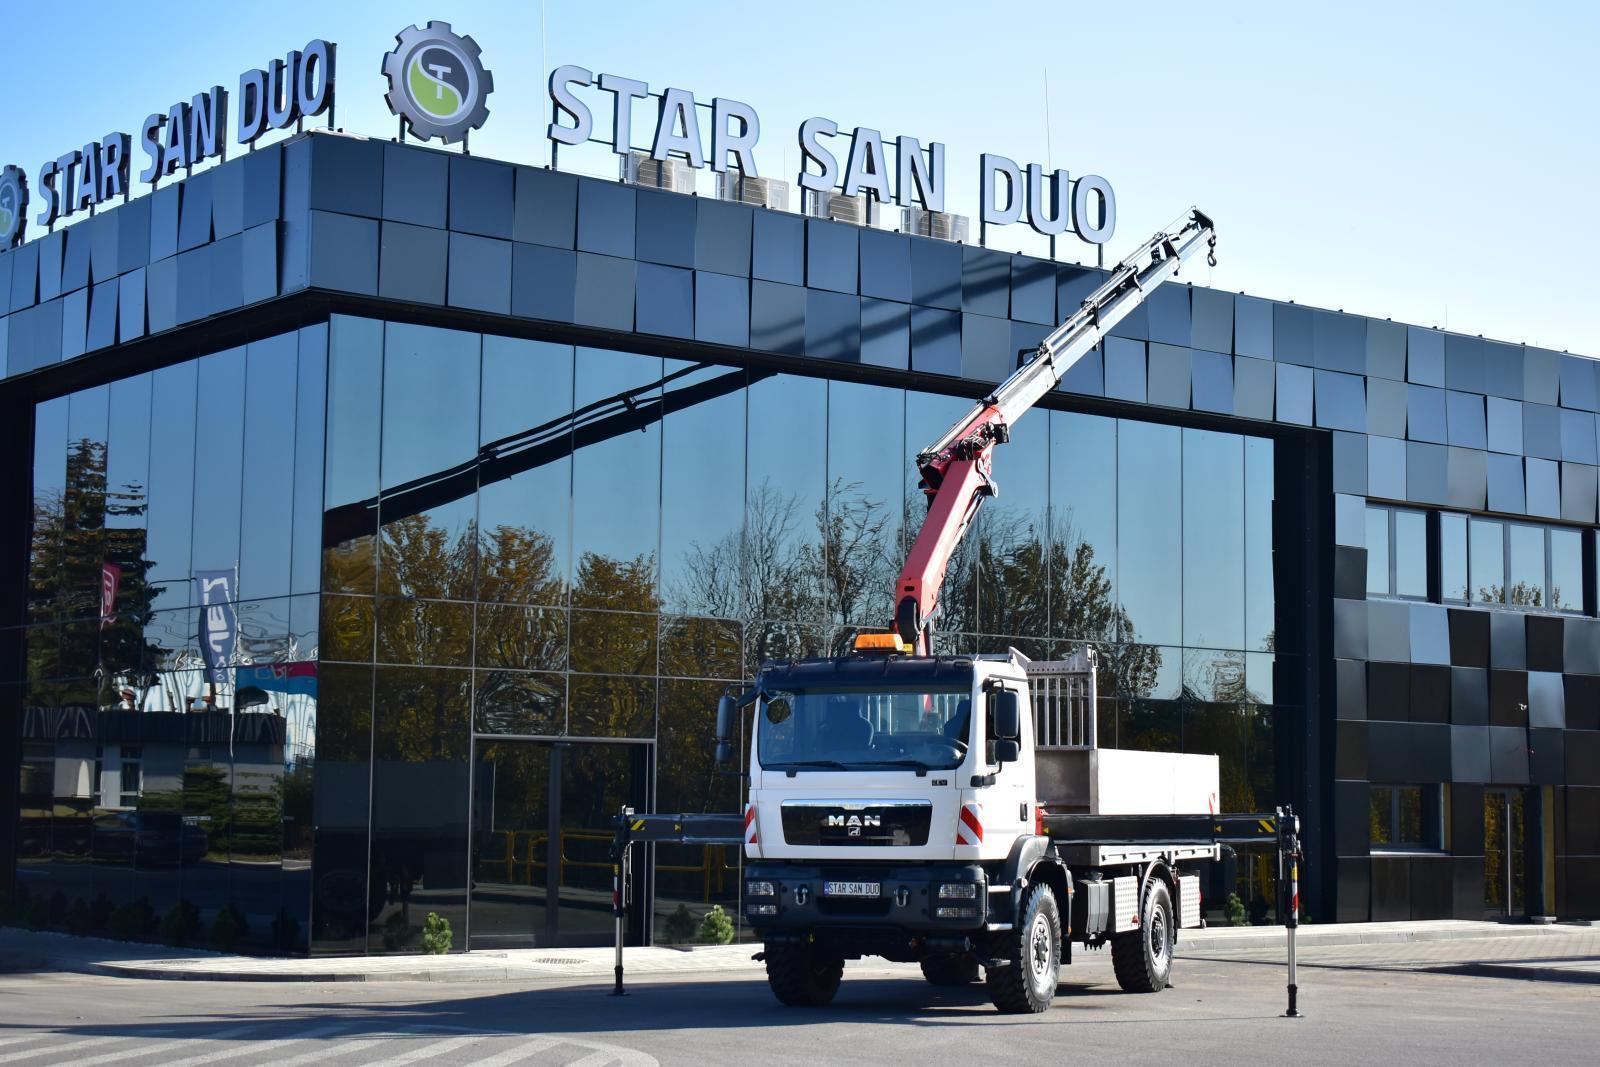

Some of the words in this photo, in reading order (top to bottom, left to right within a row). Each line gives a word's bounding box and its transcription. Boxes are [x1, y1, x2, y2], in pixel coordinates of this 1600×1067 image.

[37, 131, 130, 226] STAR
[140, 85, 226, 183] SAN
[238, 39, 334, 145] DUO
[547, 64, 760, 178] STAR
[797, 117, 945, 213] SAN
[979, 152, 1116, 244] DUO
[828, 815, 881, 827] MAN
[828, 882, 847, 895] STAR
[849, 882, 863, 895] SAN
[865, 883, 880, 896] DUO
